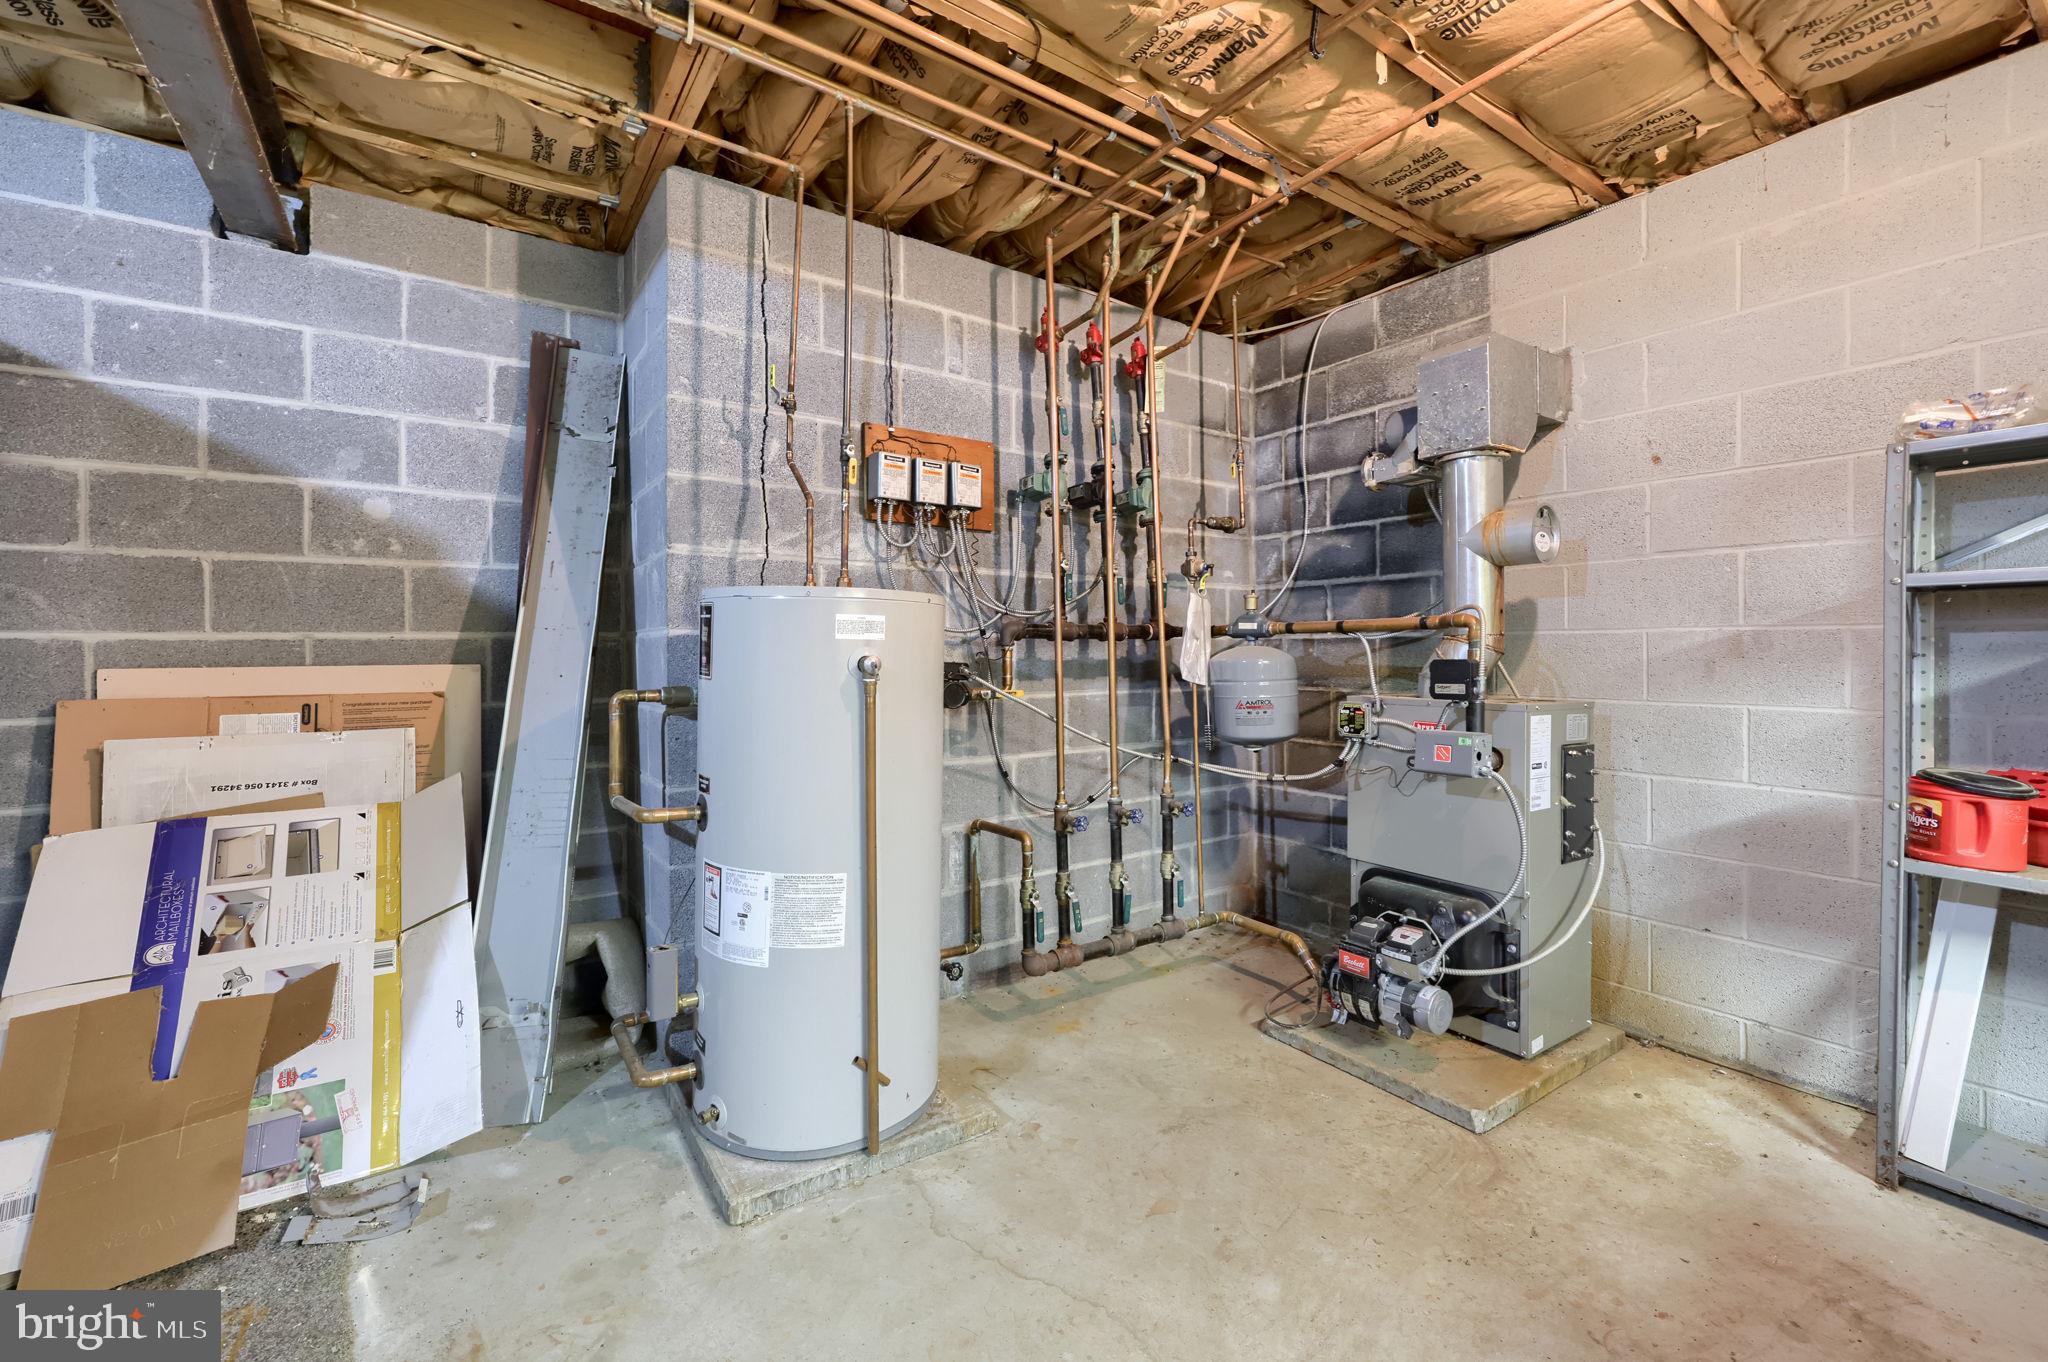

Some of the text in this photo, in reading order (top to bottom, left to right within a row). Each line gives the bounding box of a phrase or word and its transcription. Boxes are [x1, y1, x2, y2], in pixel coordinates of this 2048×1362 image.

[1188, 23, 1269, 86] Manville
[1807, 15, 1941, 72] Manville
[1168, 45, 1208, 76] Glass
[1412, 146, 1443, 165] Enjoy
[1383, 167, 1421, 187] Energy
[1407, 173, 1482, 206] Manville
[210, 784, 242, 792] 34291
[244, 782, 263, 790] 056
[265, 781, 290, 789] 3141
[154, 869, 175, 942] ARCHITECTURAL
[166, 886, 185, 942] MAILBOXES
[1343, 955, 1365, 969] Beckett
